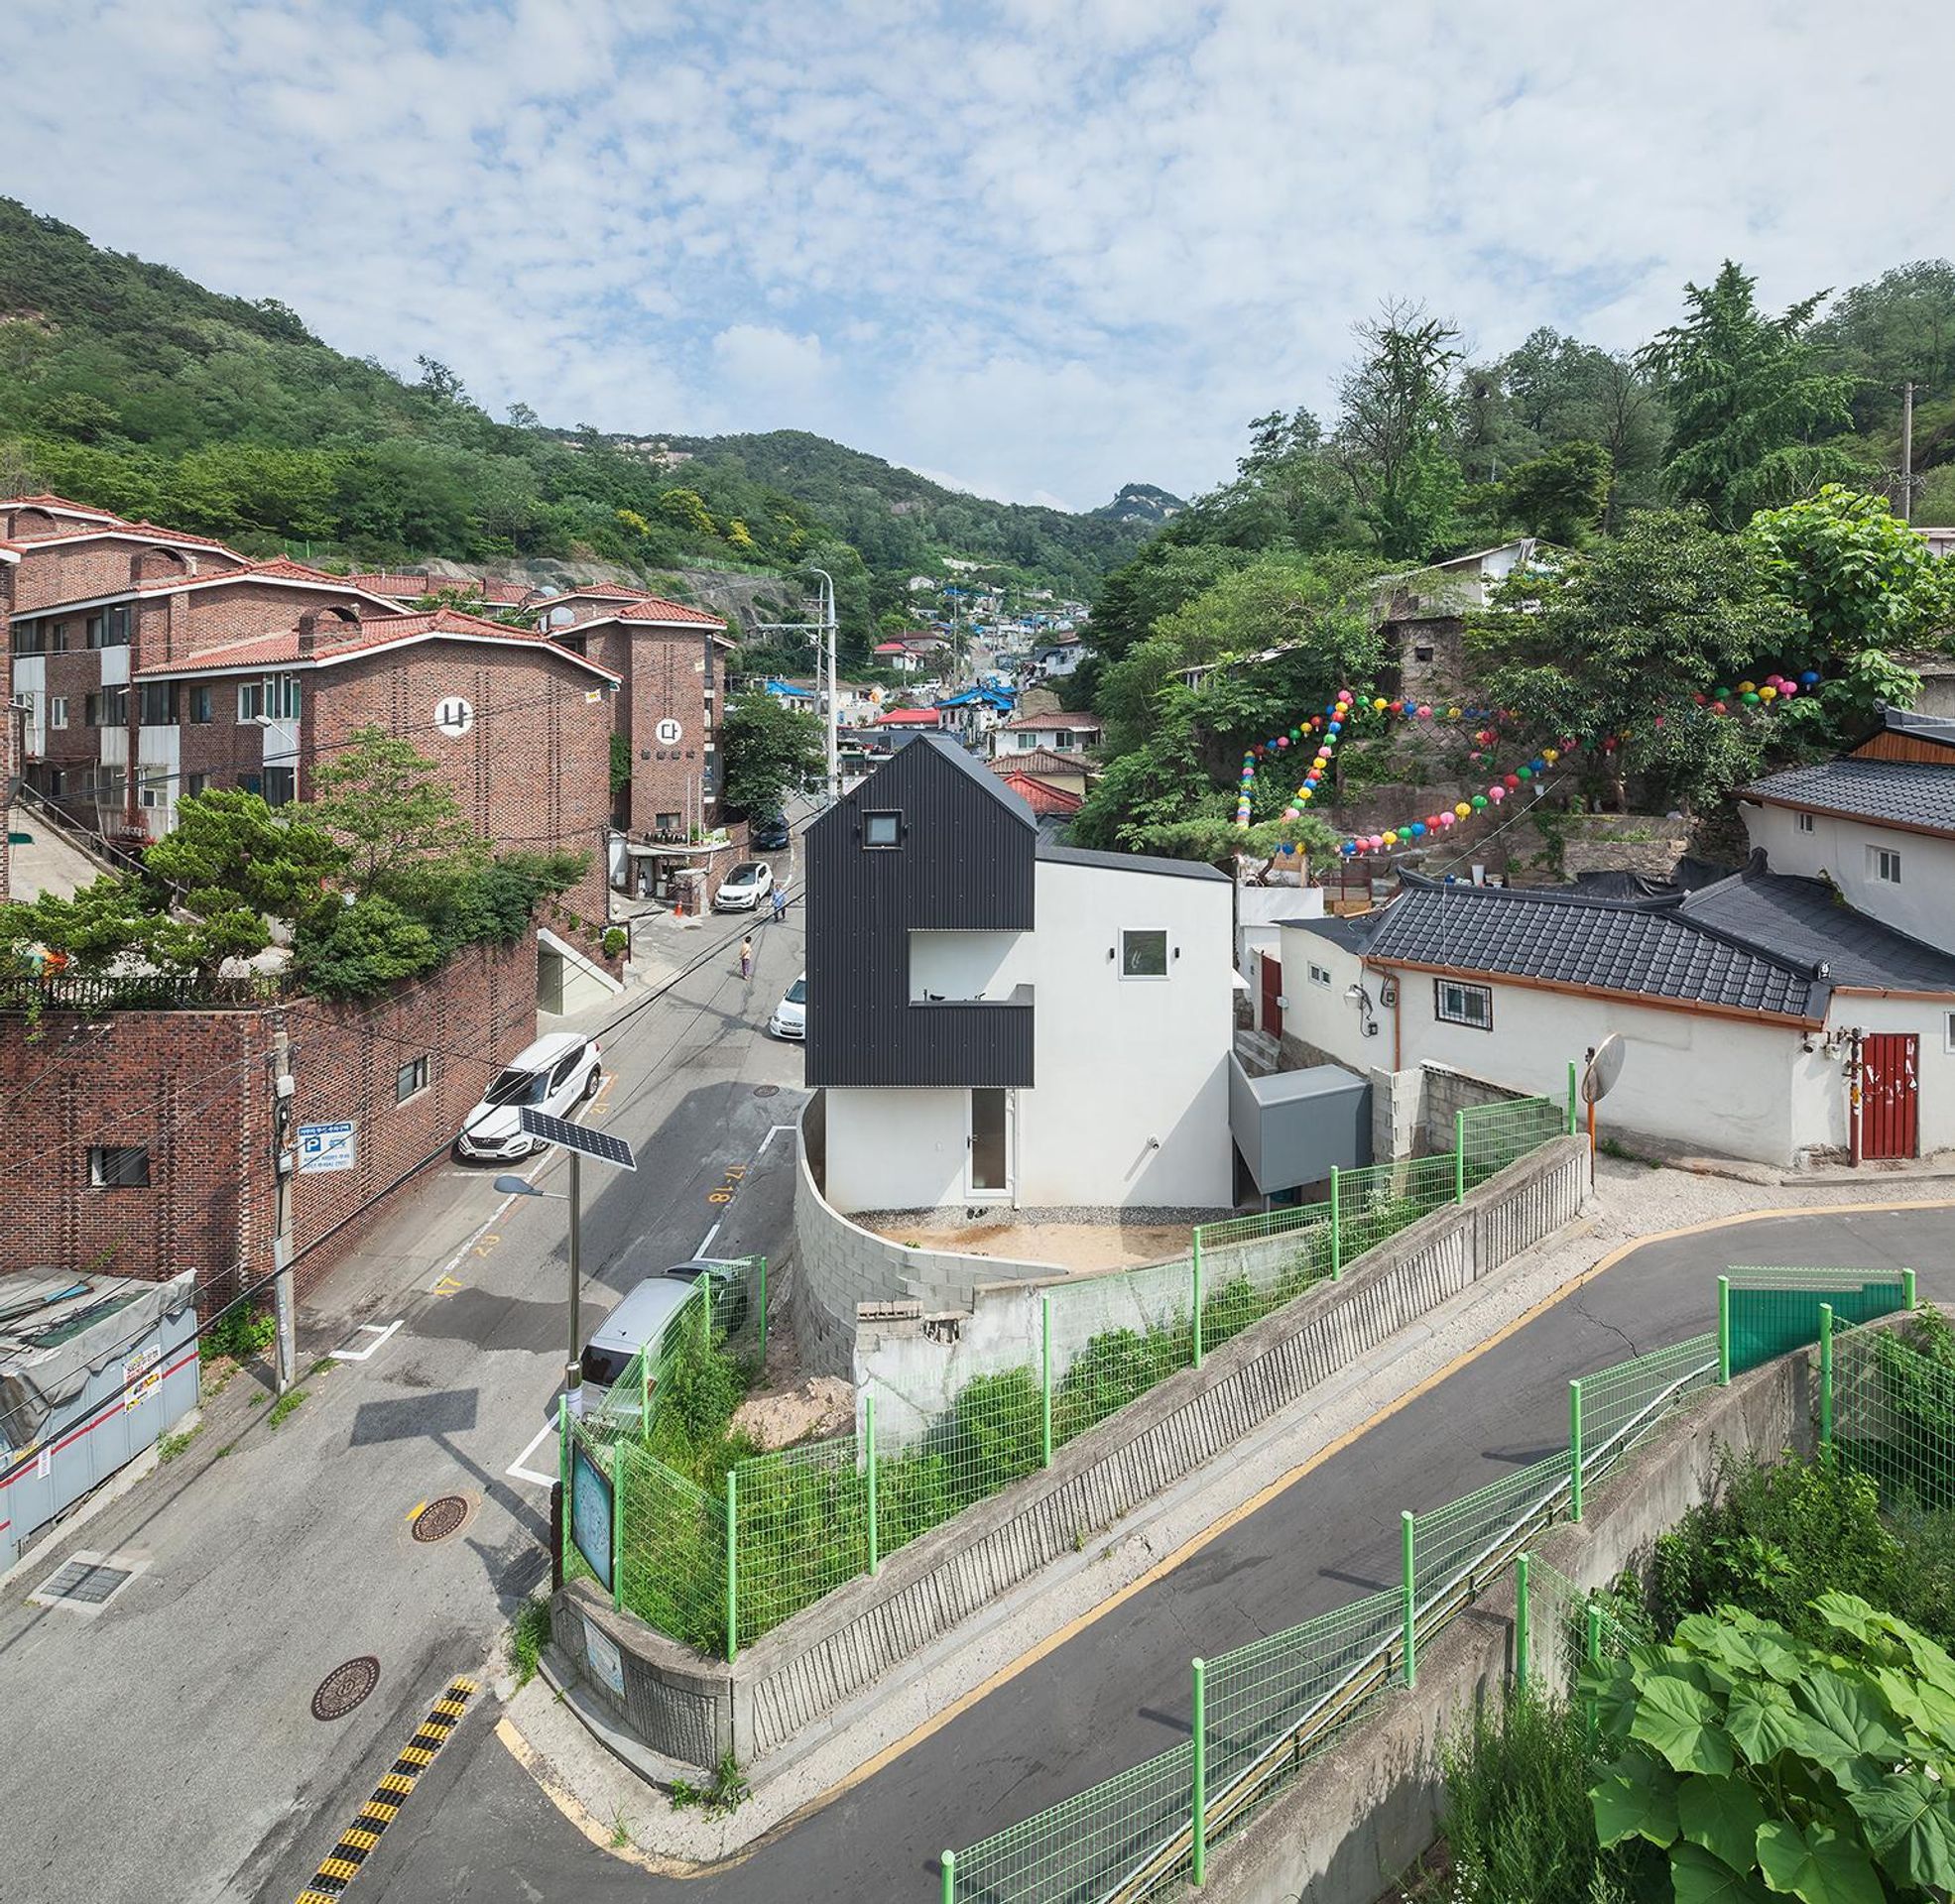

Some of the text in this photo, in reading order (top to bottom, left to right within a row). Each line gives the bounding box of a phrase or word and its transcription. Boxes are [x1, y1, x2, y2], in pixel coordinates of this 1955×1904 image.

[444, 702, 467, 728] 나
[661, 723, 678, 741] 다
[306, 1138, 319, 1151] P
